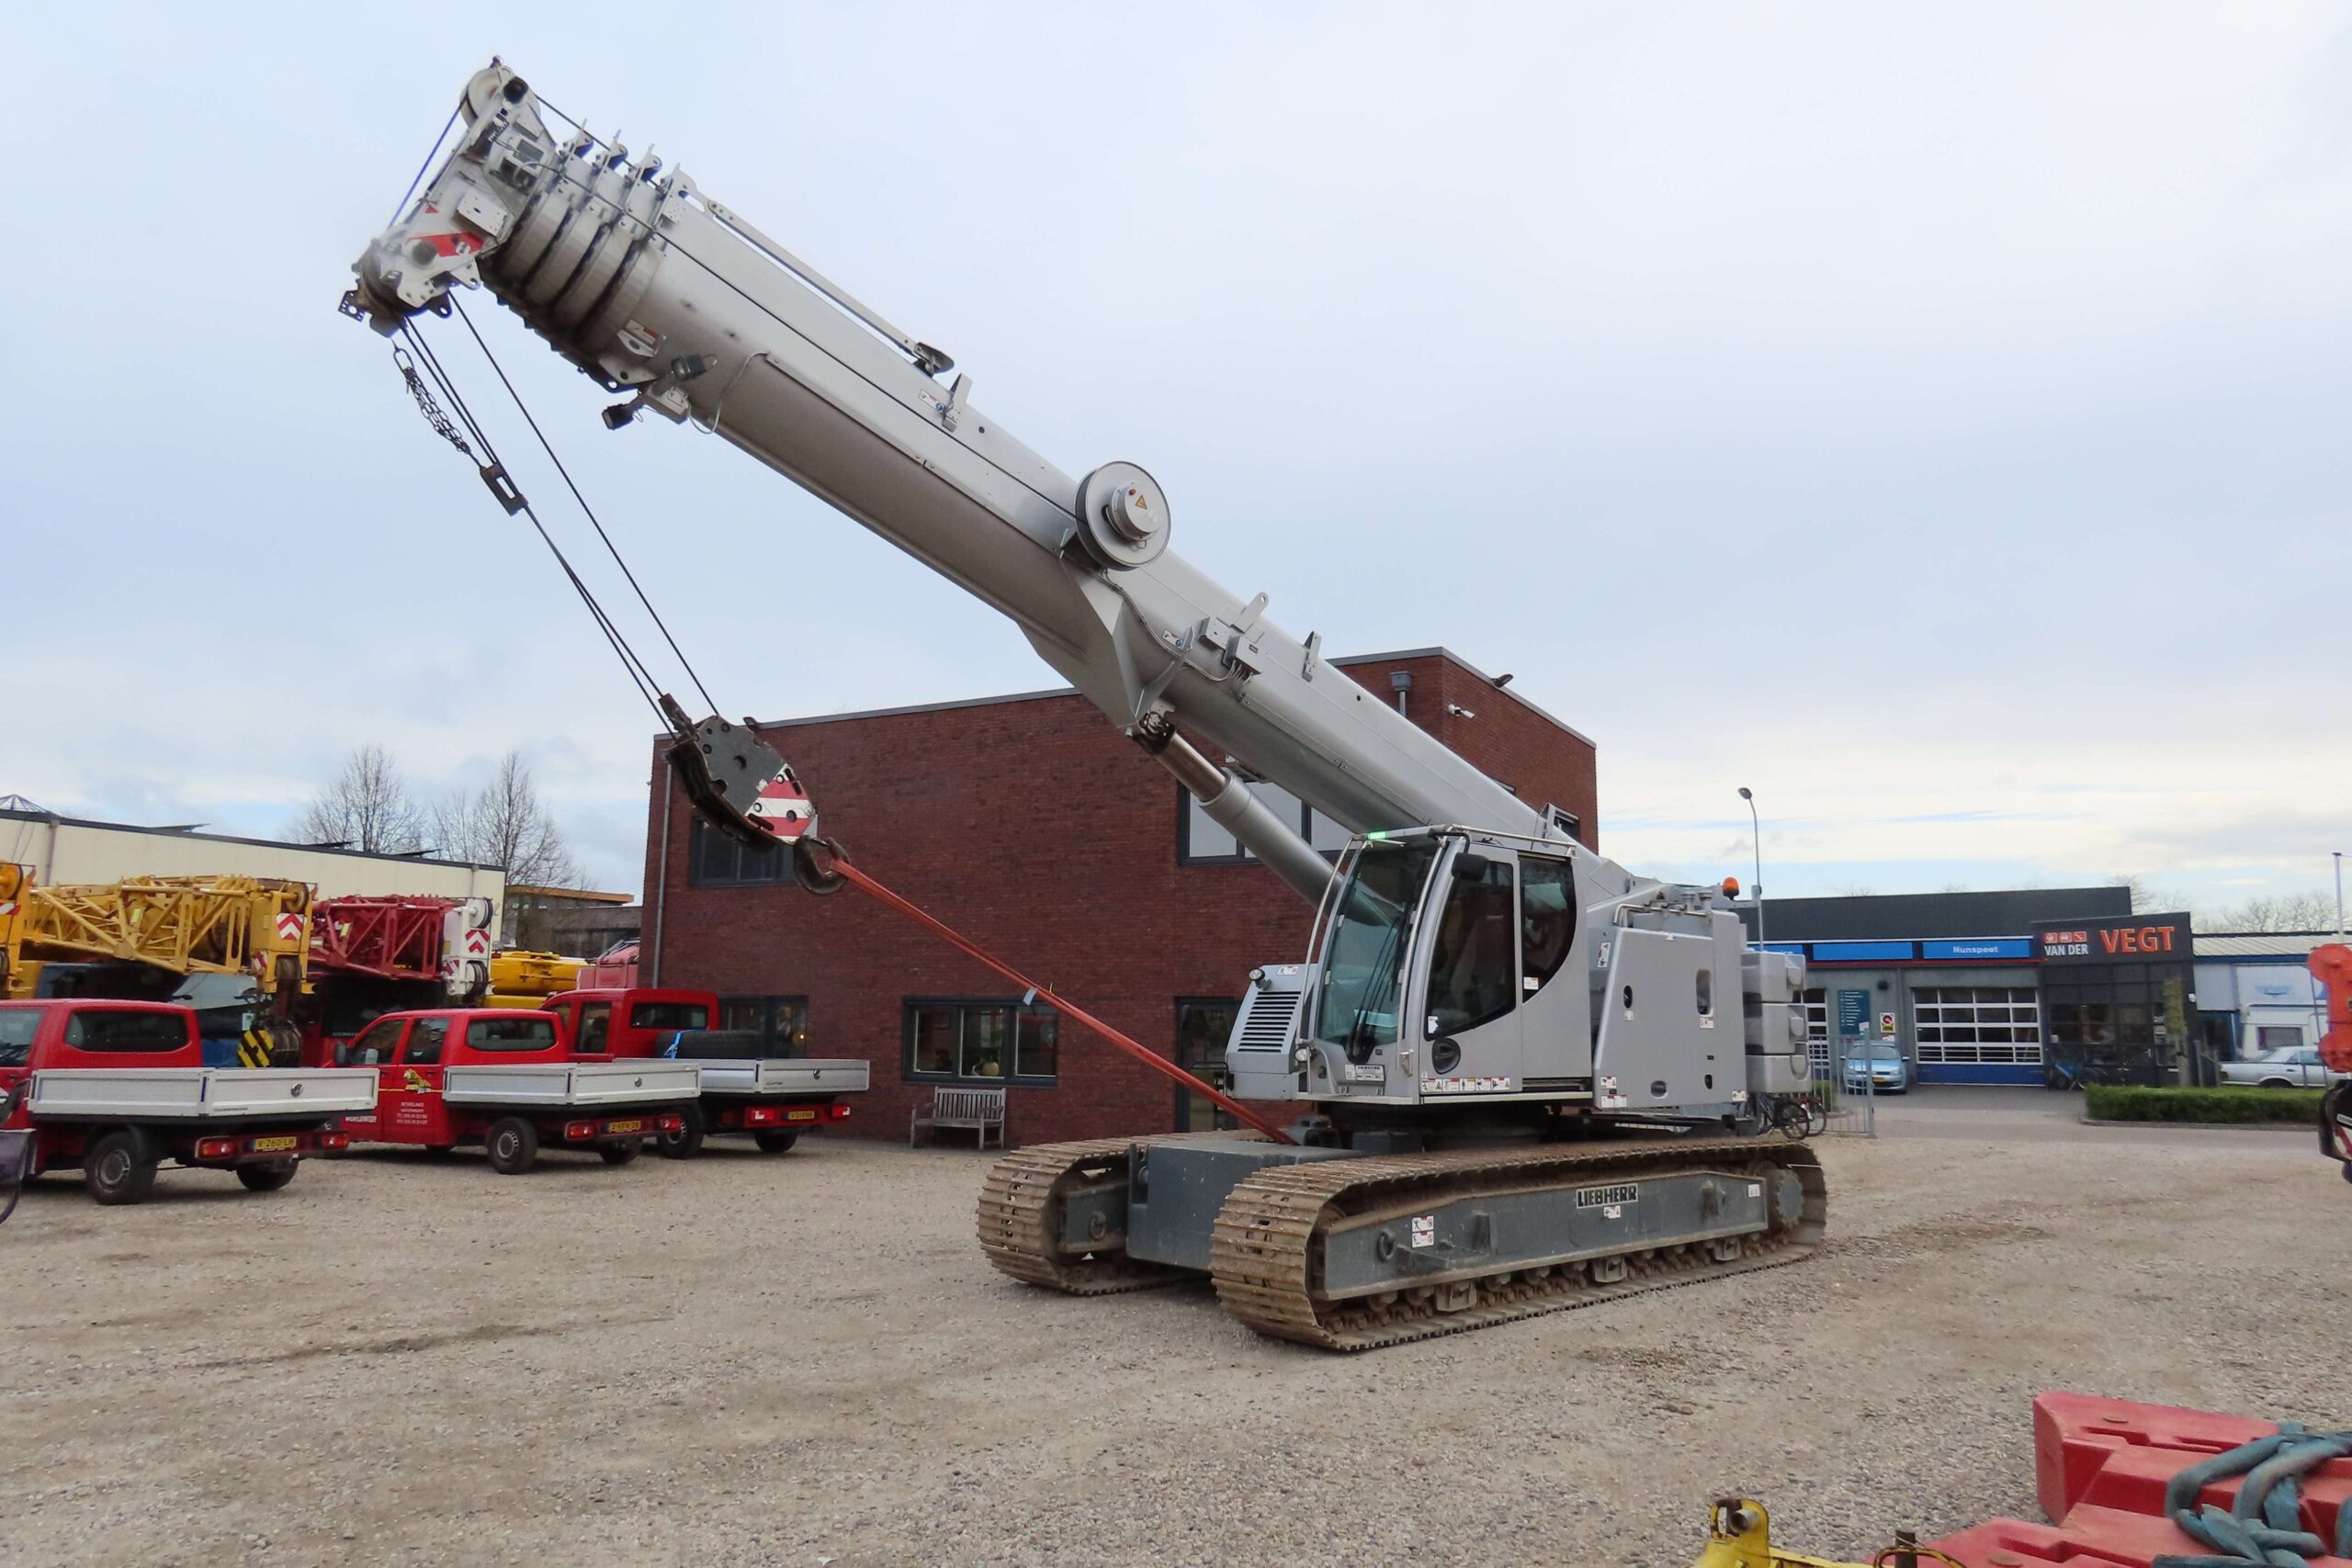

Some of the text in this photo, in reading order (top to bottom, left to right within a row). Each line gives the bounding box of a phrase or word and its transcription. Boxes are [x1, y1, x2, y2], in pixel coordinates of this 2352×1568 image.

[2044, 926, 2174, 956] VAN DER VEGT
[1577, 1186, 1638, 1208] LIEBHERR
